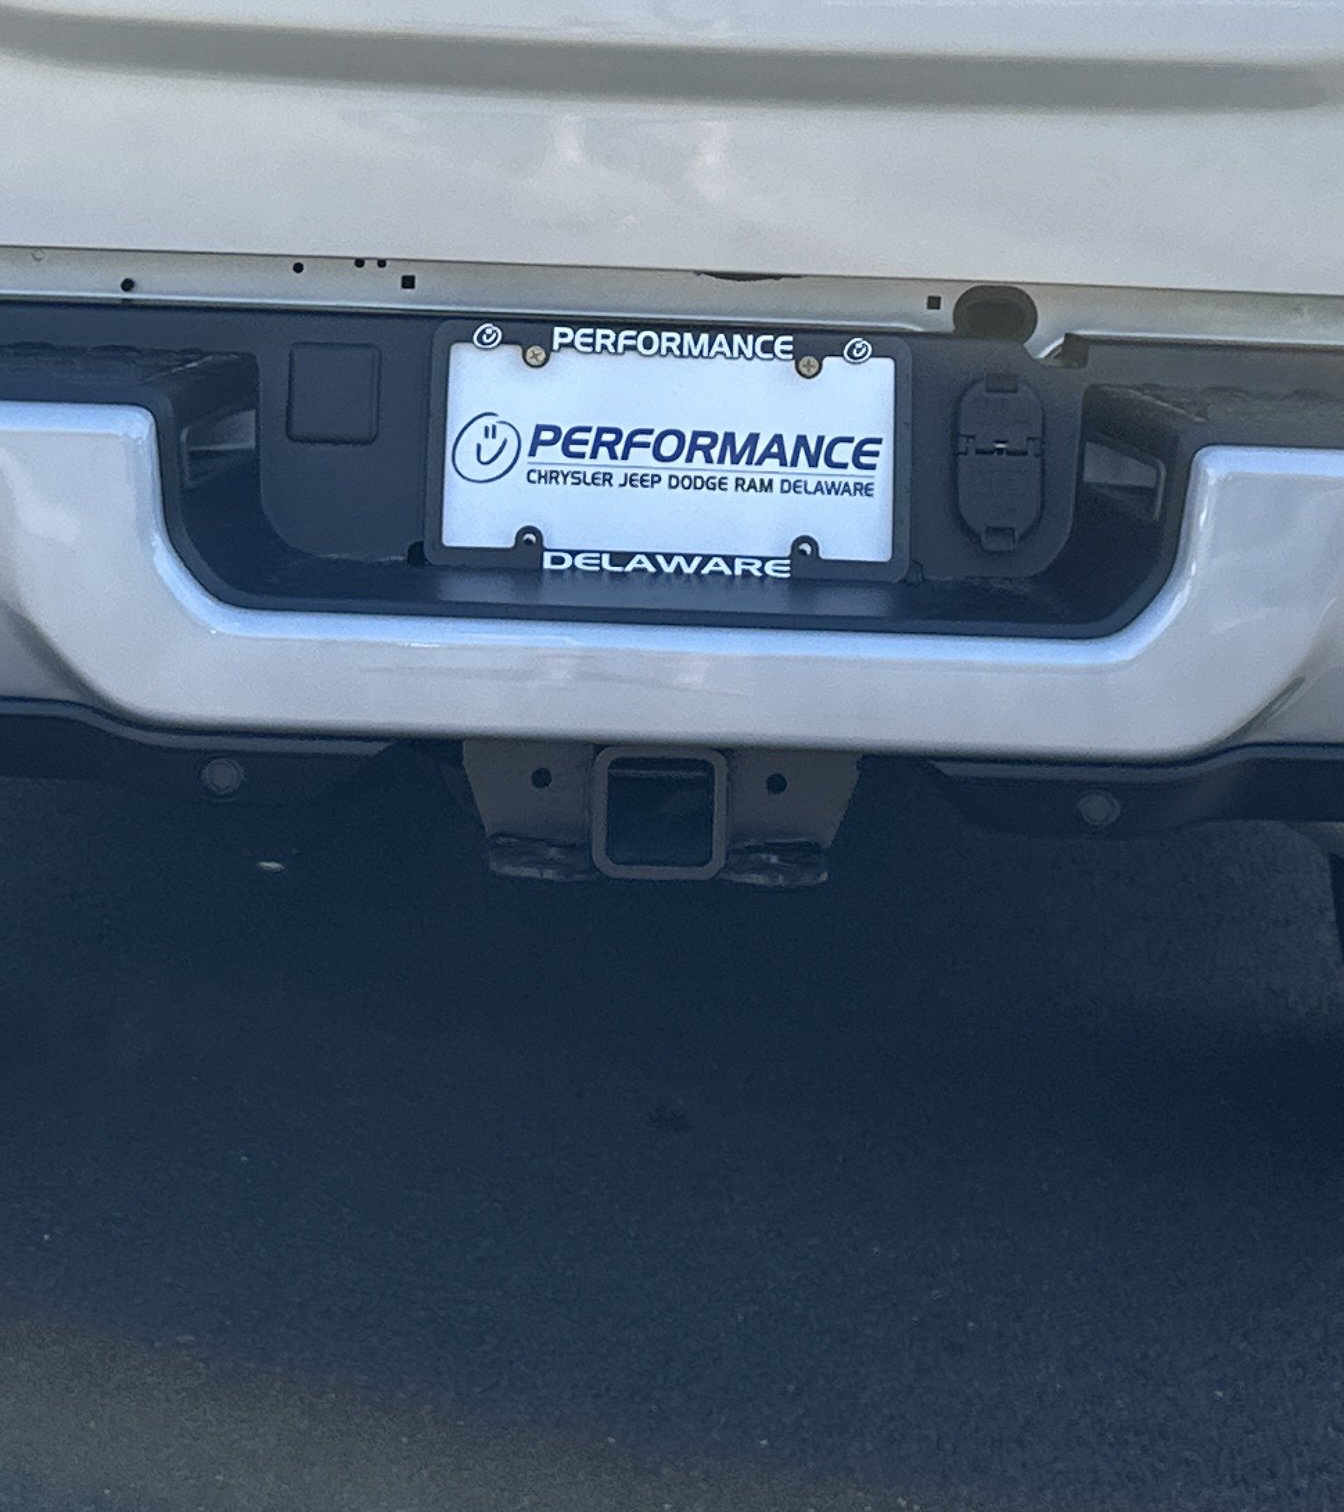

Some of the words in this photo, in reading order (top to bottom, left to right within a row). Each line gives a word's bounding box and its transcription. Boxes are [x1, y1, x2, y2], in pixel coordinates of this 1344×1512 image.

[551, 326, 794, 361] PERFORMANCE
[528, 424, 883, 470] PERFORMANCE
[526, 469, 613, 487] CHRYSLER
[618, 472, 662, 489] JEEP
[668, 474, 728, 491] DODGE
[734, 477, 774, 493] RAM
[779, 478, 875, 497] DELAWARE
[543, 551, 792, 579] DELAWARE
